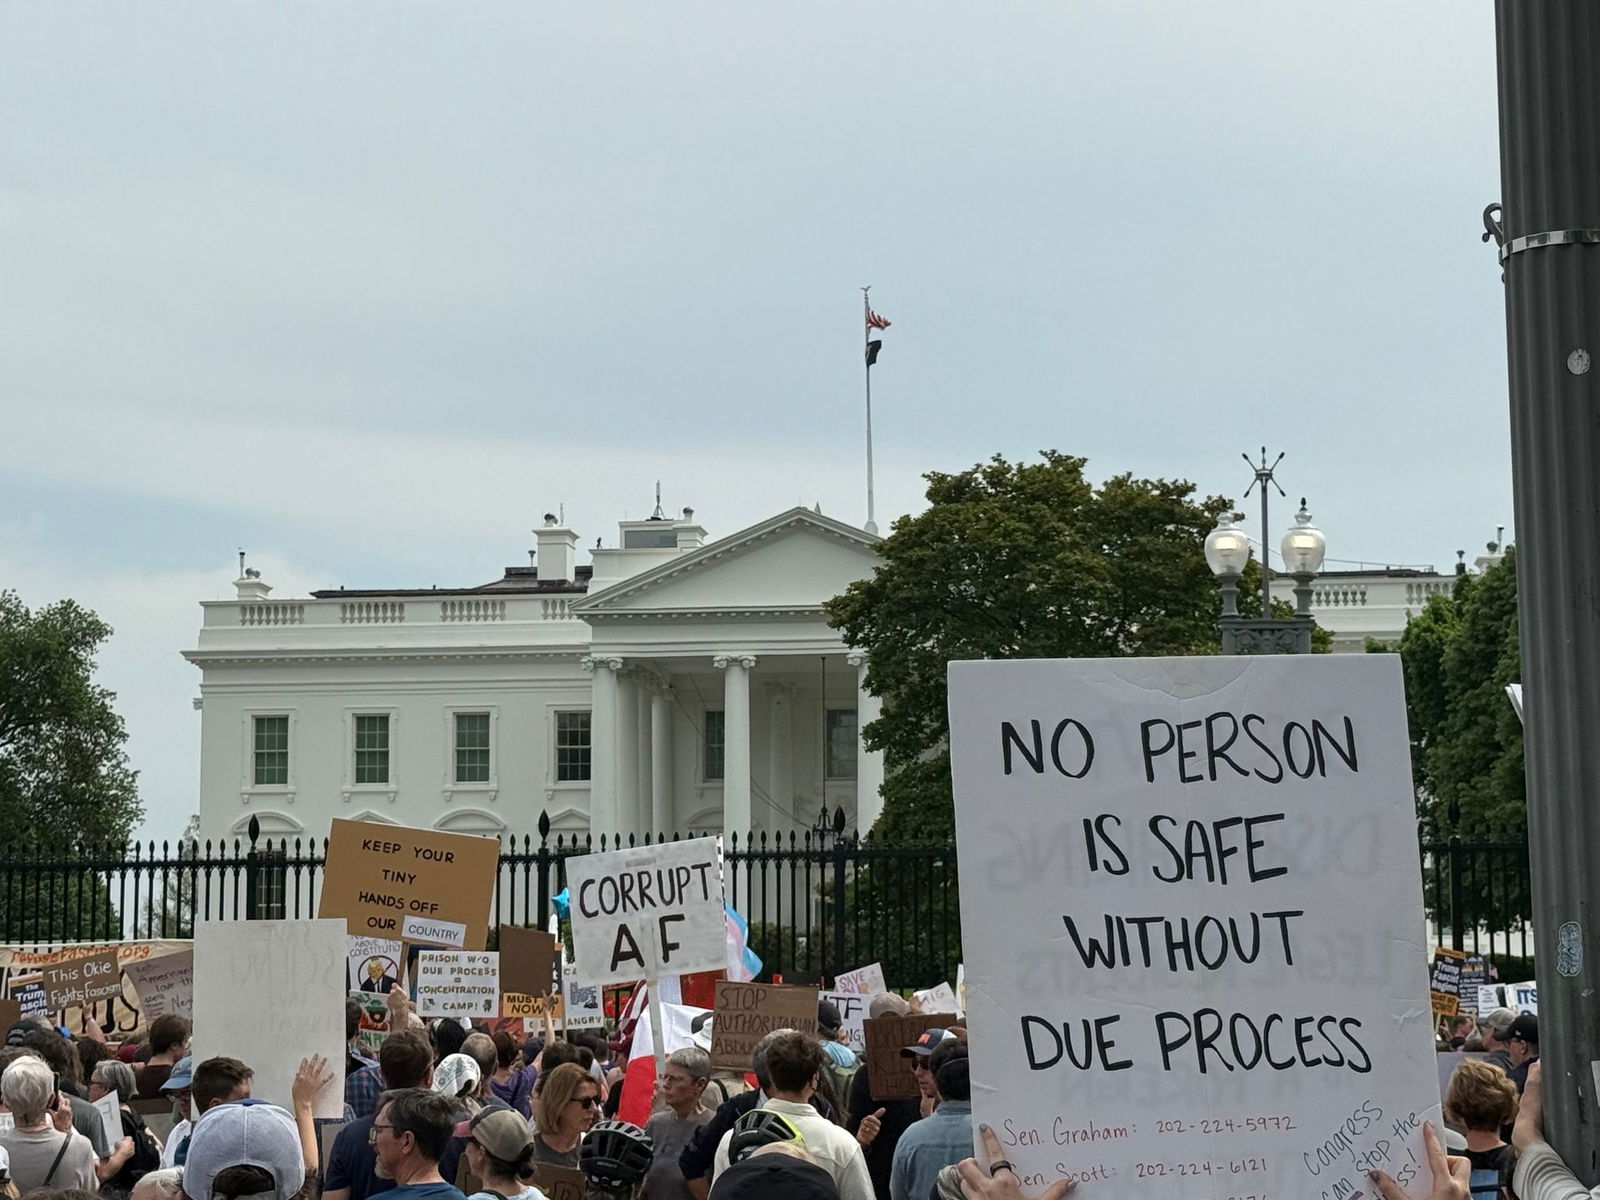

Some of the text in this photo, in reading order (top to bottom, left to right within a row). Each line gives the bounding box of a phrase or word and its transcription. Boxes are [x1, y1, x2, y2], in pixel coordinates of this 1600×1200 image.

[1001, 711, 1359, 784] NO PERSON
[362, 839, 455, 863] KEEP YOUR
[1083, 812, 1288, 885] IS SAFE
[382, 869, 416, 885] TINY
[579, 861, 712, 918] CORRUPT
[358, 891, 440, 914] HANDS OFF
[367, 917, 459, 941] OUR COUNTRY
[1062, 910, 1304, 972] WITHOUT
[421, 954, 459, 963] PRISON
[48, 968, 79, 984] This
[83, 962, 112, 978] Okie
[422, 966, 497, 976] DUE PROCESS
[840, 971, 865, 989] SAVE
[15, 990, 44, 1002] Trum
[50, 986, 85, 1008] Fights
[418, 985, 495, 995] CONCENTRATION
[506, 995, 538, 1004] MUST
[720, 987, 767, 1010] STOP
[442, 1002, 478, 1010] CAMP!
[567, 1016, 602, 1026] ANGRY
[1020, 1007, 1373, 1074] DUE PROCESS
[1003, 1116, 1297, 1147] Sen. Graham: 202-224-5972
[1303, 1100, 1383, 1176] Congress
[1356, 1140, 1391, 1178] stop
[1392, 1112, 1421, 1142] the
[1055, 1162, 1117, 1183] Scott:
[1136, 1158, 1268, 1178] 202-224-6121
